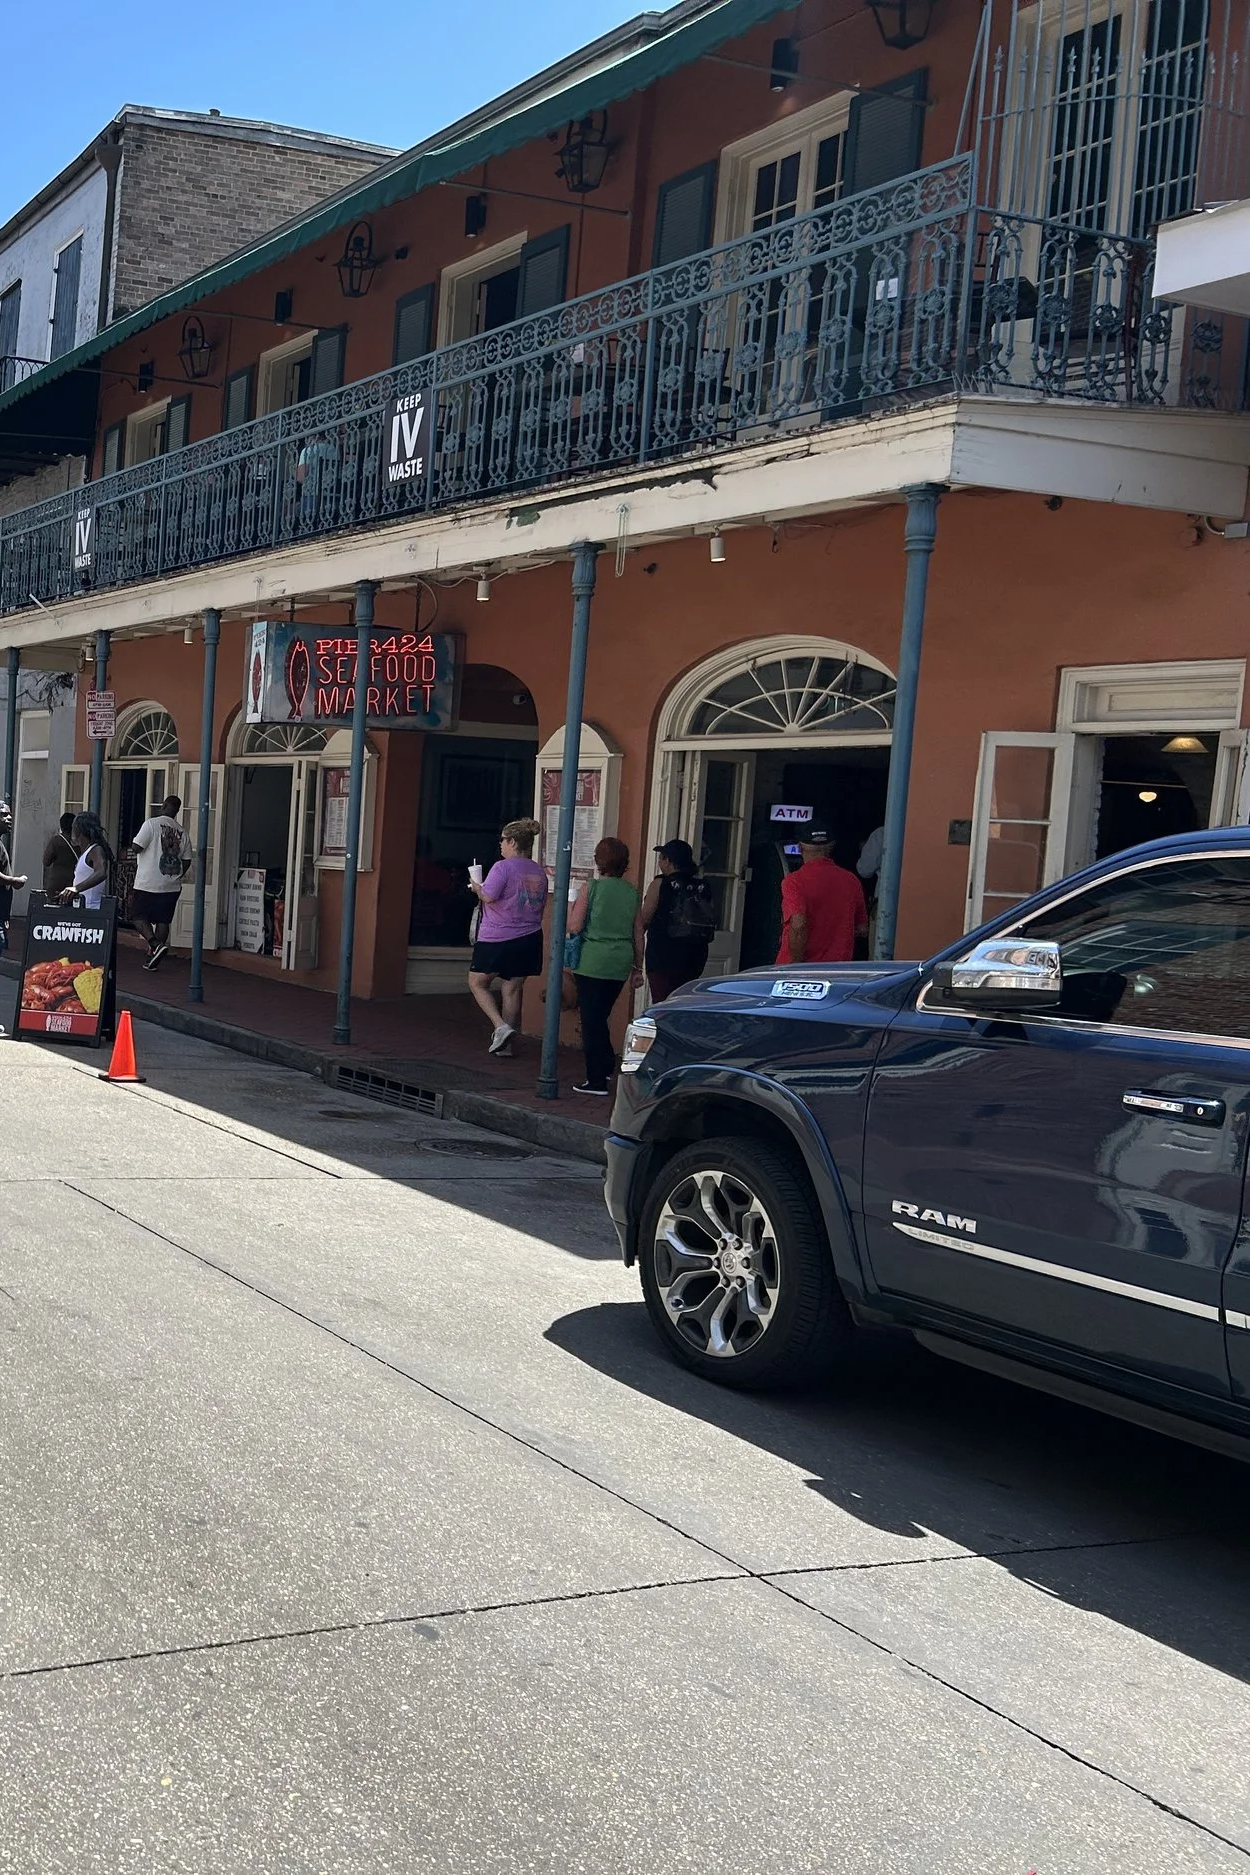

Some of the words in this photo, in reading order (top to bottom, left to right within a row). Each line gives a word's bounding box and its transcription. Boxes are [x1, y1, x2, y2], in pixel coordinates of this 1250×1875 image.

[397, 393, 422, 413] KEEP
[391, 407, 425, 463] IV
[389, 457, 423, 482] WASTE
[78, 508, 90, 520] KEEP
[75, 518, 91, 556] IV
[75, 553, 91, 569] WASTE
[775, 808, 809, 819] ATM
[33, 925, 104, 944] CRAWFISH
[781, 982, 822, 992] 1500
[892, 1200, 976, 1234] RAM
[908, 1227, 975, 1251] LIMITED
